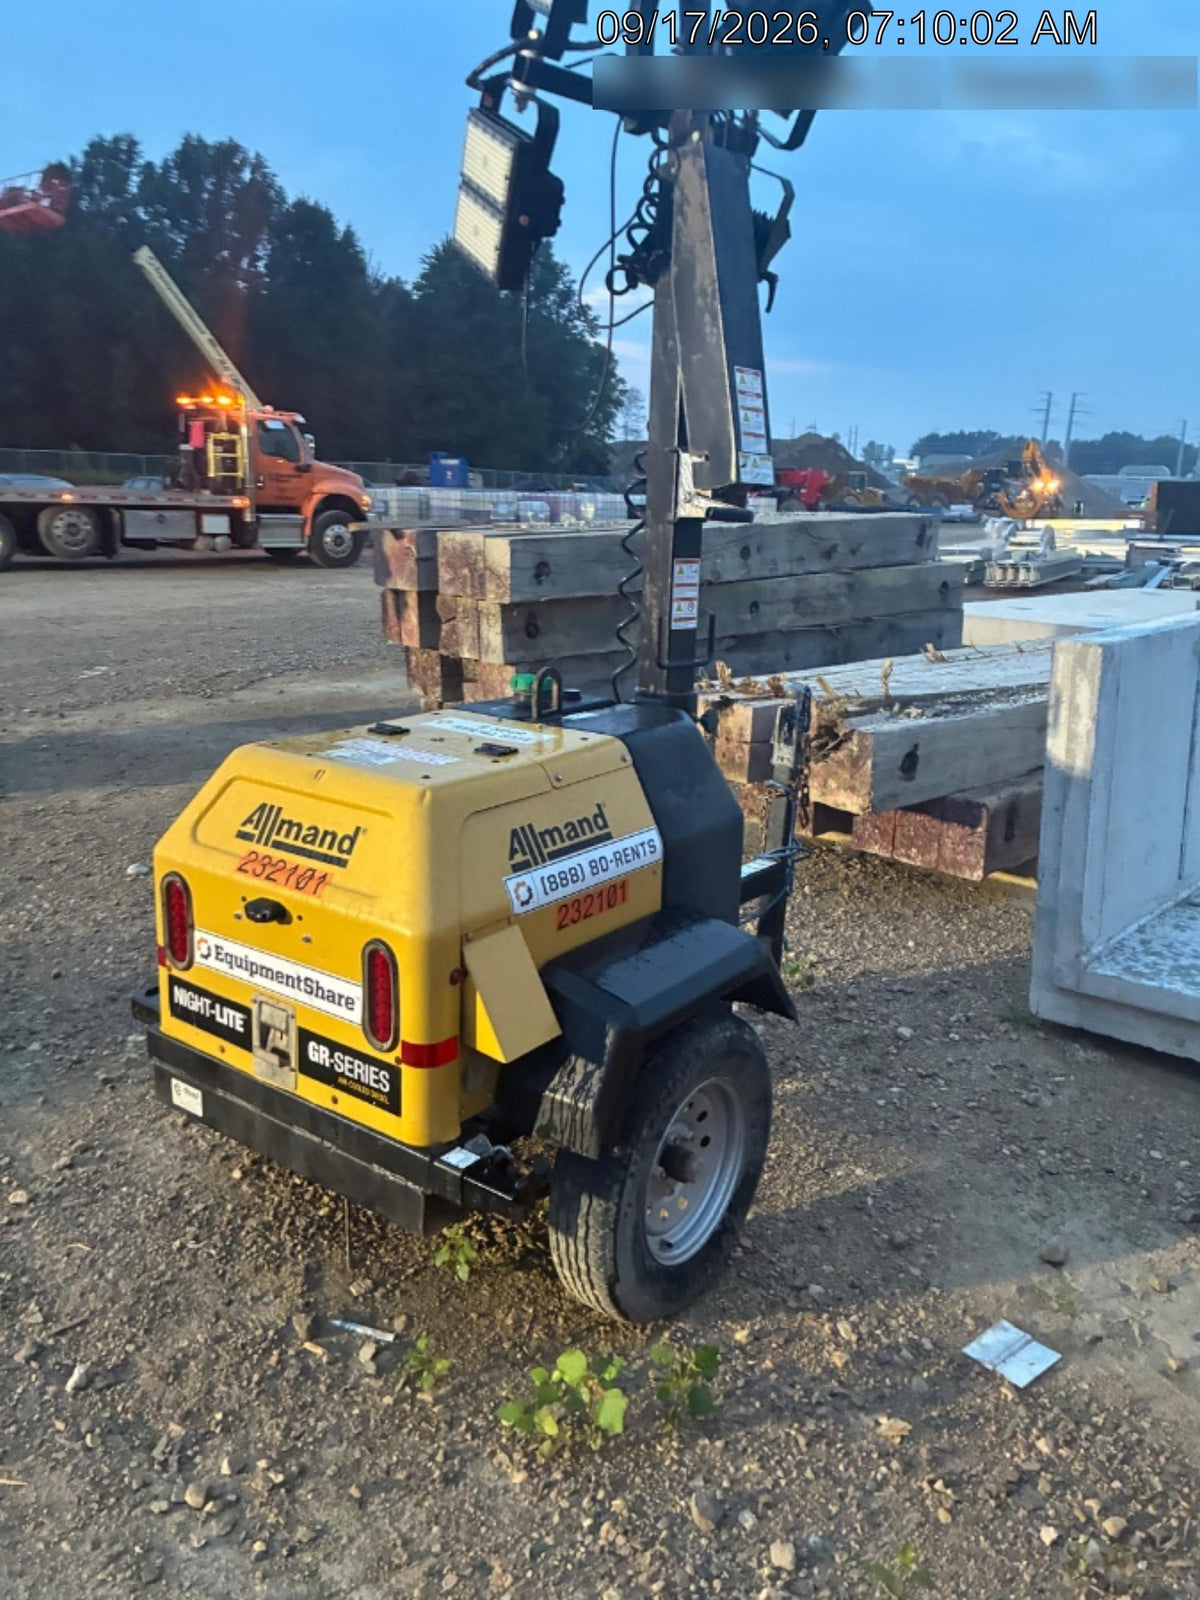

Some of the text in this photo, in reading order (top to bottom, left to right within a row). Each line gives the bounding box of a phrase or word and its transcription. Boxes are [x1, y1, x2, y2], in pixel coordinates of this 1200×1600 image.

[240, 802, 362, 857] Allmand
[508, 803, 601, 866] Allmand
[237, 850, 328, 895] 232101
[540, 838, 657, 897] (888) 80-RENTS
[556, 880, 628, 931] 232101
[214, 944, 356, 1011] EquipmentShare
[173, 984, 246, 1034] NIGHT-LITE
[307, 1040, 390, 1093] GR-SERIES
